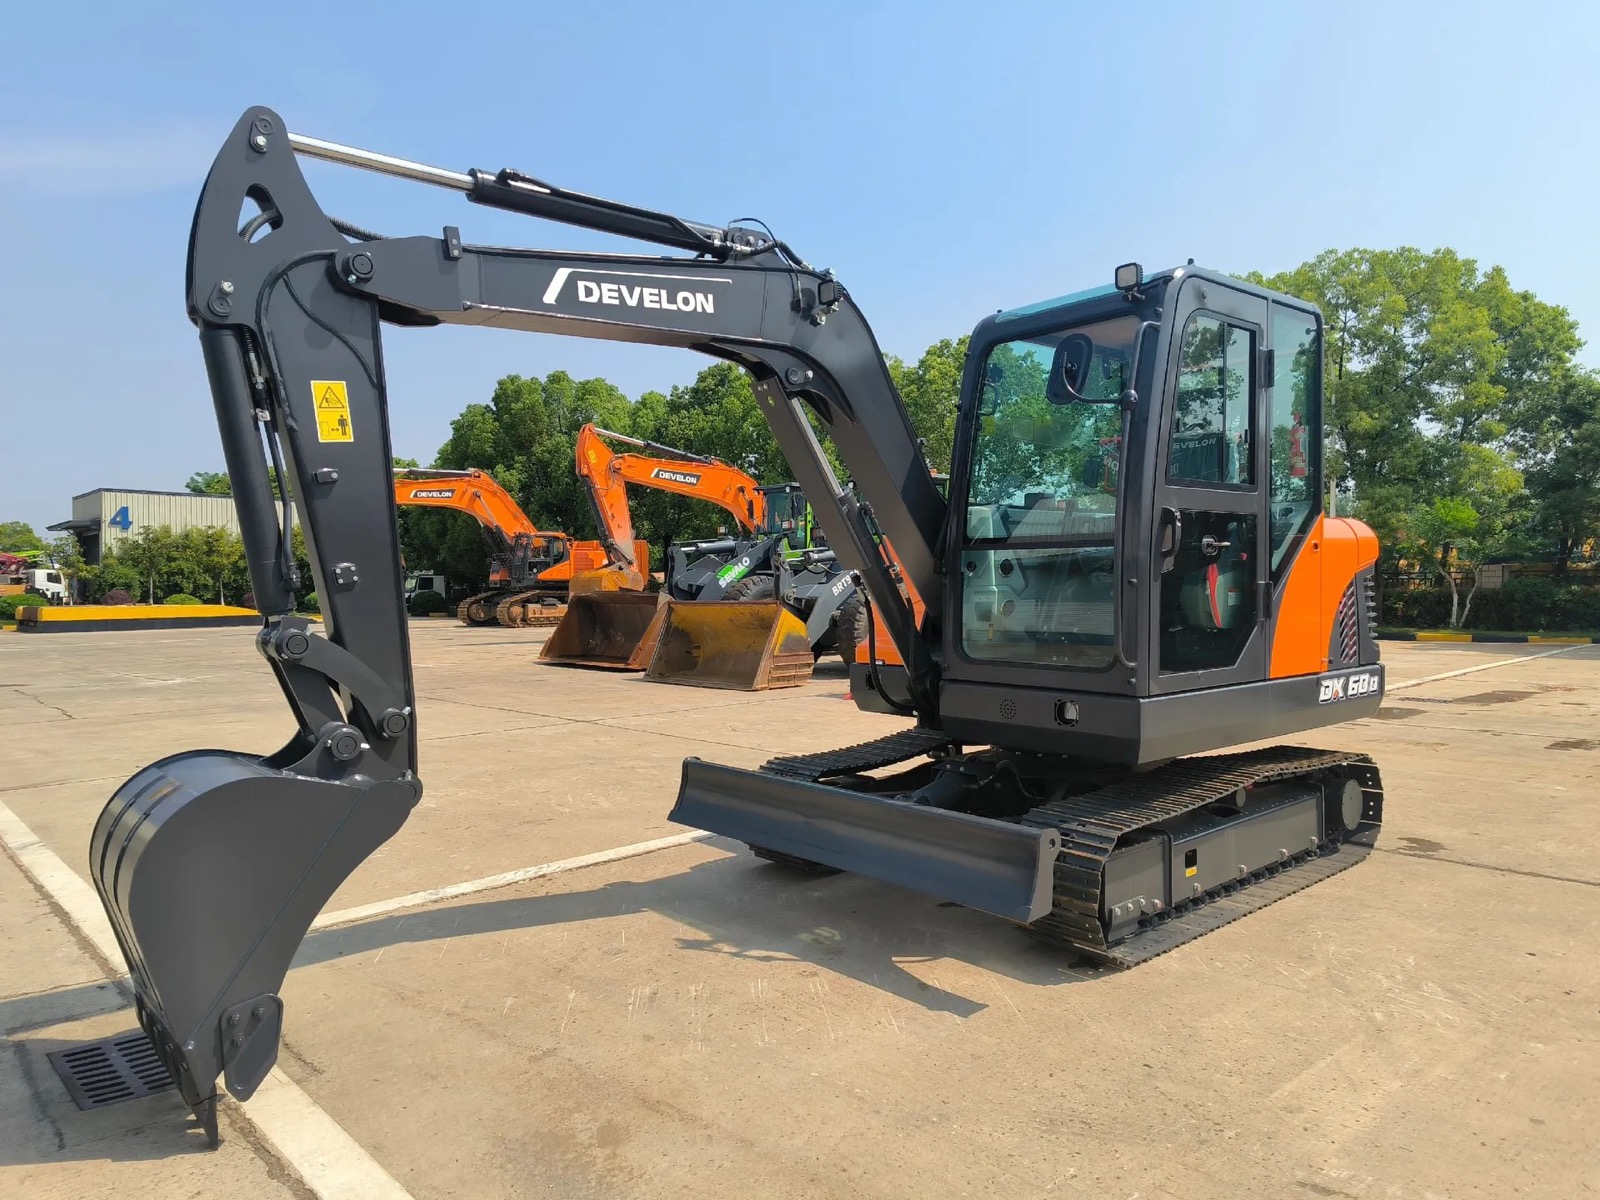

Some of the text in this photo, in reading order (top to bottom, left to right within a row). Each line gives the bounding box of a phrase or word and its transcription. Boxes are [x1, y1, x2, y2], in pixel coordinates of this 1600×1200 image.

[577, 280, 715, 314] DEVELON
[659, 471, 697, 484] DEVELON
[109, 505, 133, 530] 4
[718, 556, 750, 588] SEVALO
[832, 569, 860, 596] BRT9
[1319, 677, 1346, 704] DX
